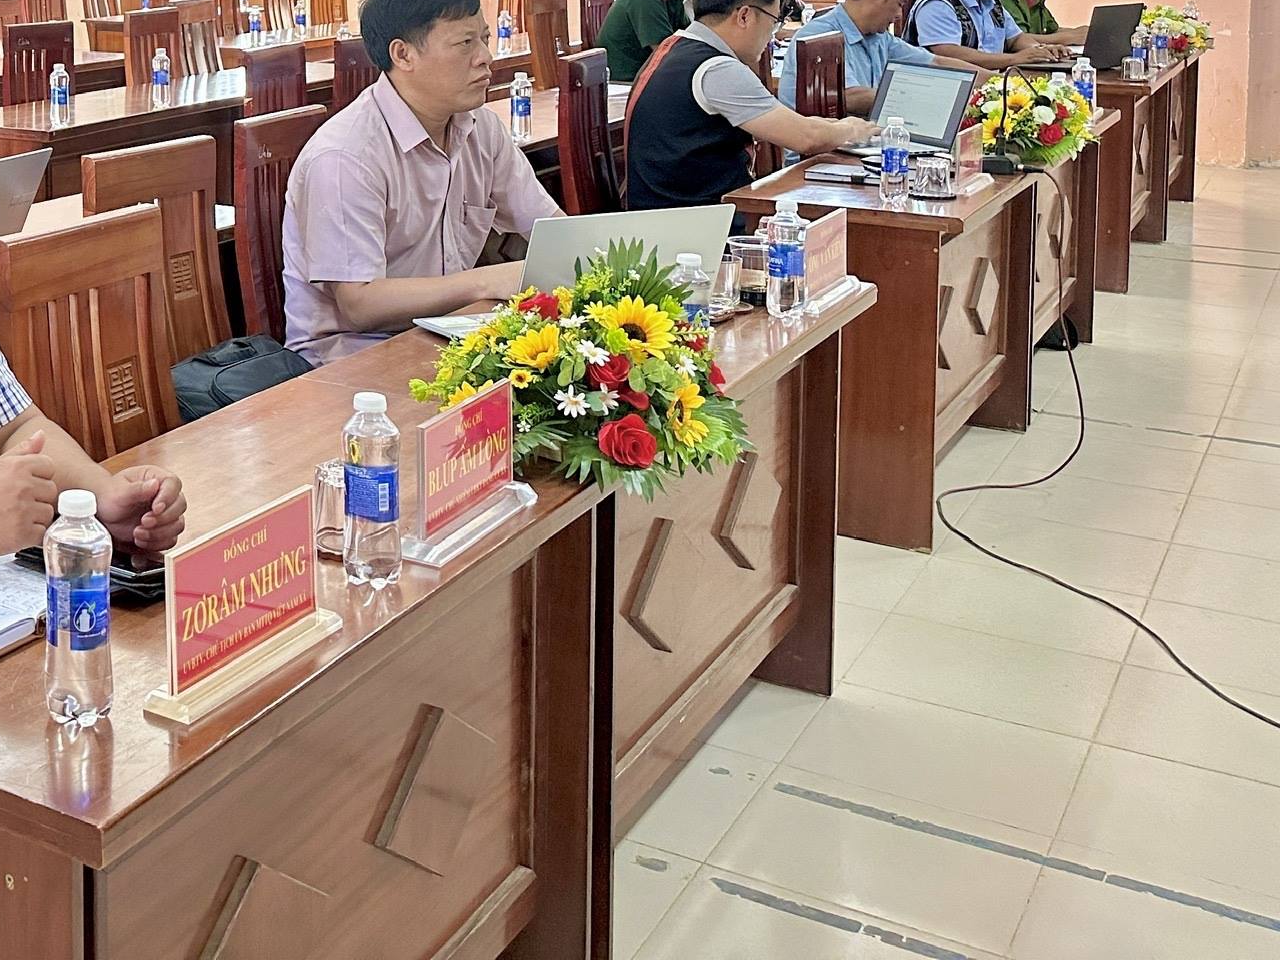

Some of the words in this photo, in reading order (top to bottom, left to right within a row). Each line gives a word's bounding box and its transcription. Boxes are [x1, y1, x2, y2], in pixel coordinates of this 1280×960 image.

[478, 427, 507, 467] LÒNG
[223, 538, 250, 563] ĐỒNG
[251, 526, 268, 548] CHÍ
[182, 576, 247, 643] ZƠRÂM
[249, 545, 307, 603] NHƯNG
